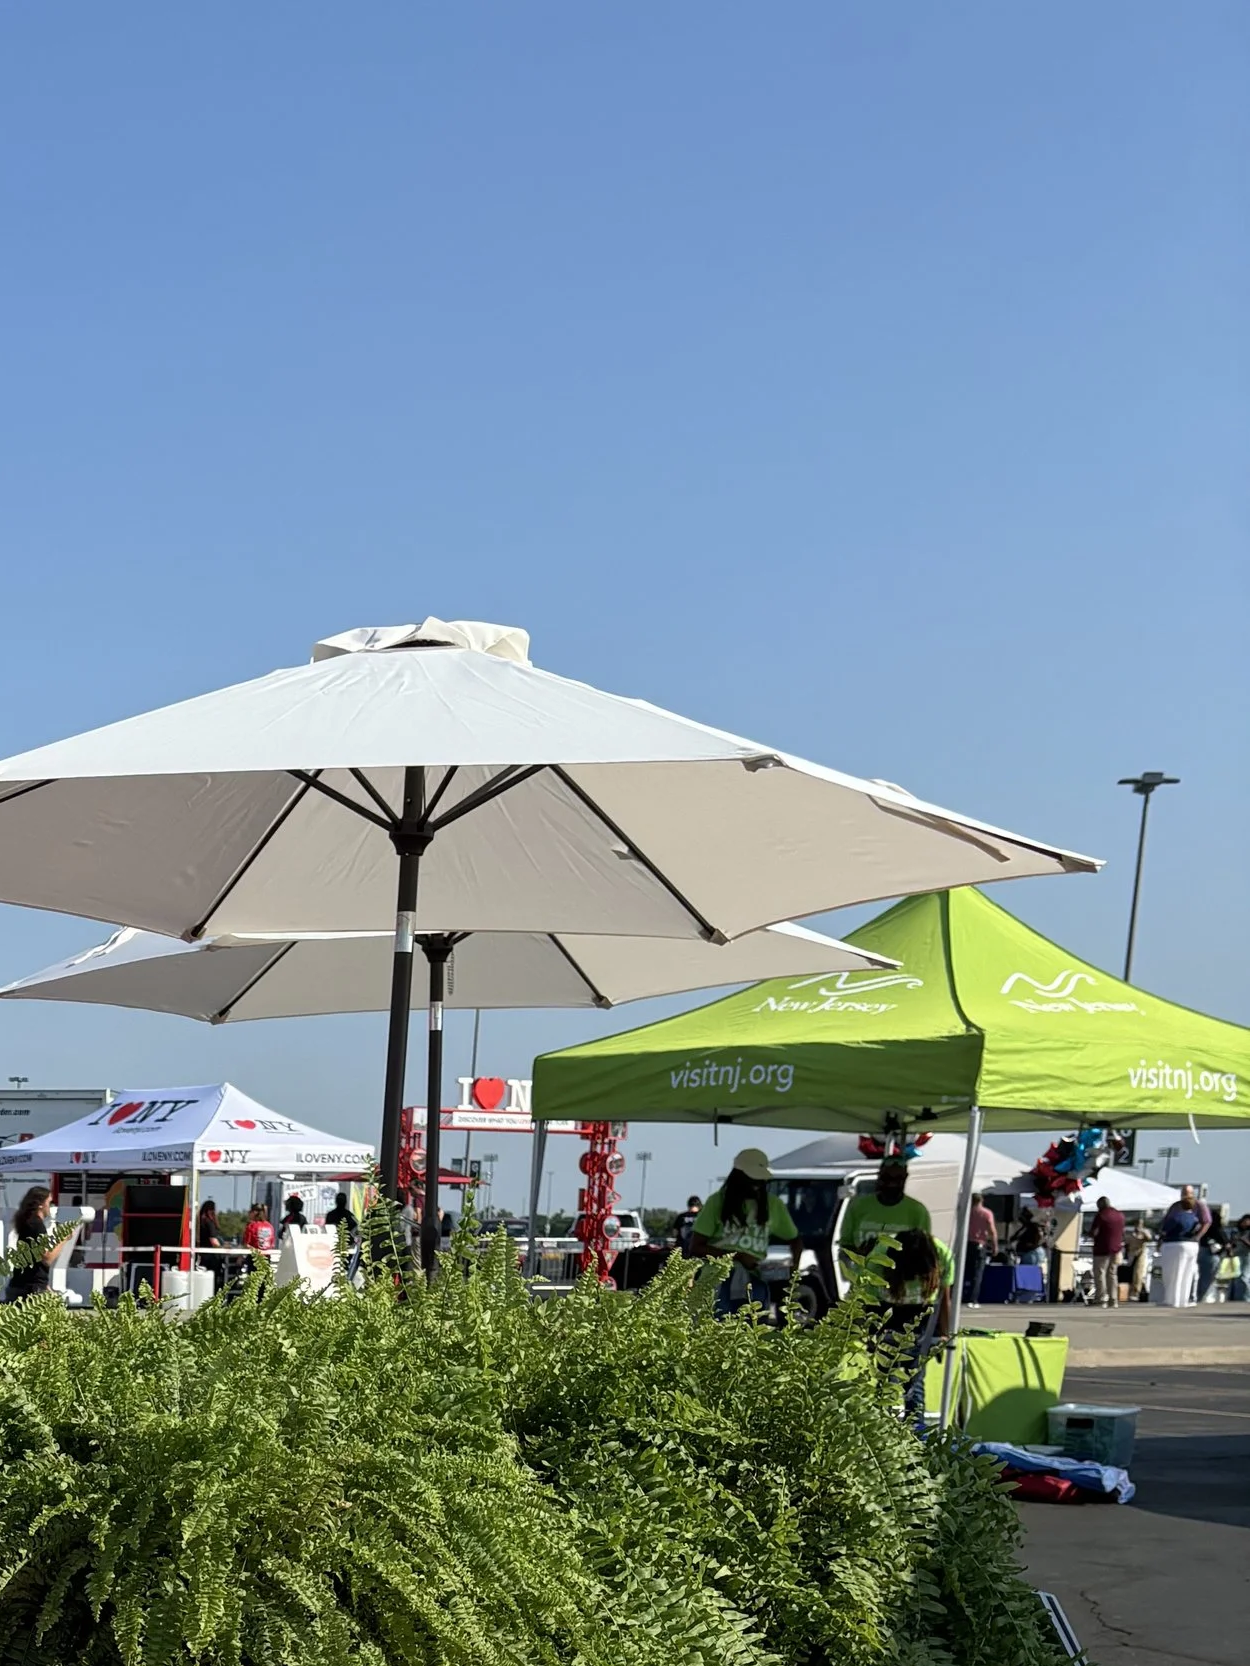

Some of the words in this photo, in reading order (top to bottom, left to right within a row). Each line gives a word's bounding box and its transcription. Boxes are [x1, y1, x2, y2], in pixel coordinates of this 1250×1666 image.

[670, 1057, 795, 1093] visitnj.org
[1128, 1060, 1238, 1101] visitnj.org
[505, 1079, 533, 1112] N
[125, 1100, 199, 1123] NY
[254, 1120, 301, 1132] NY
[223, 1150, 250, 1163] NY
